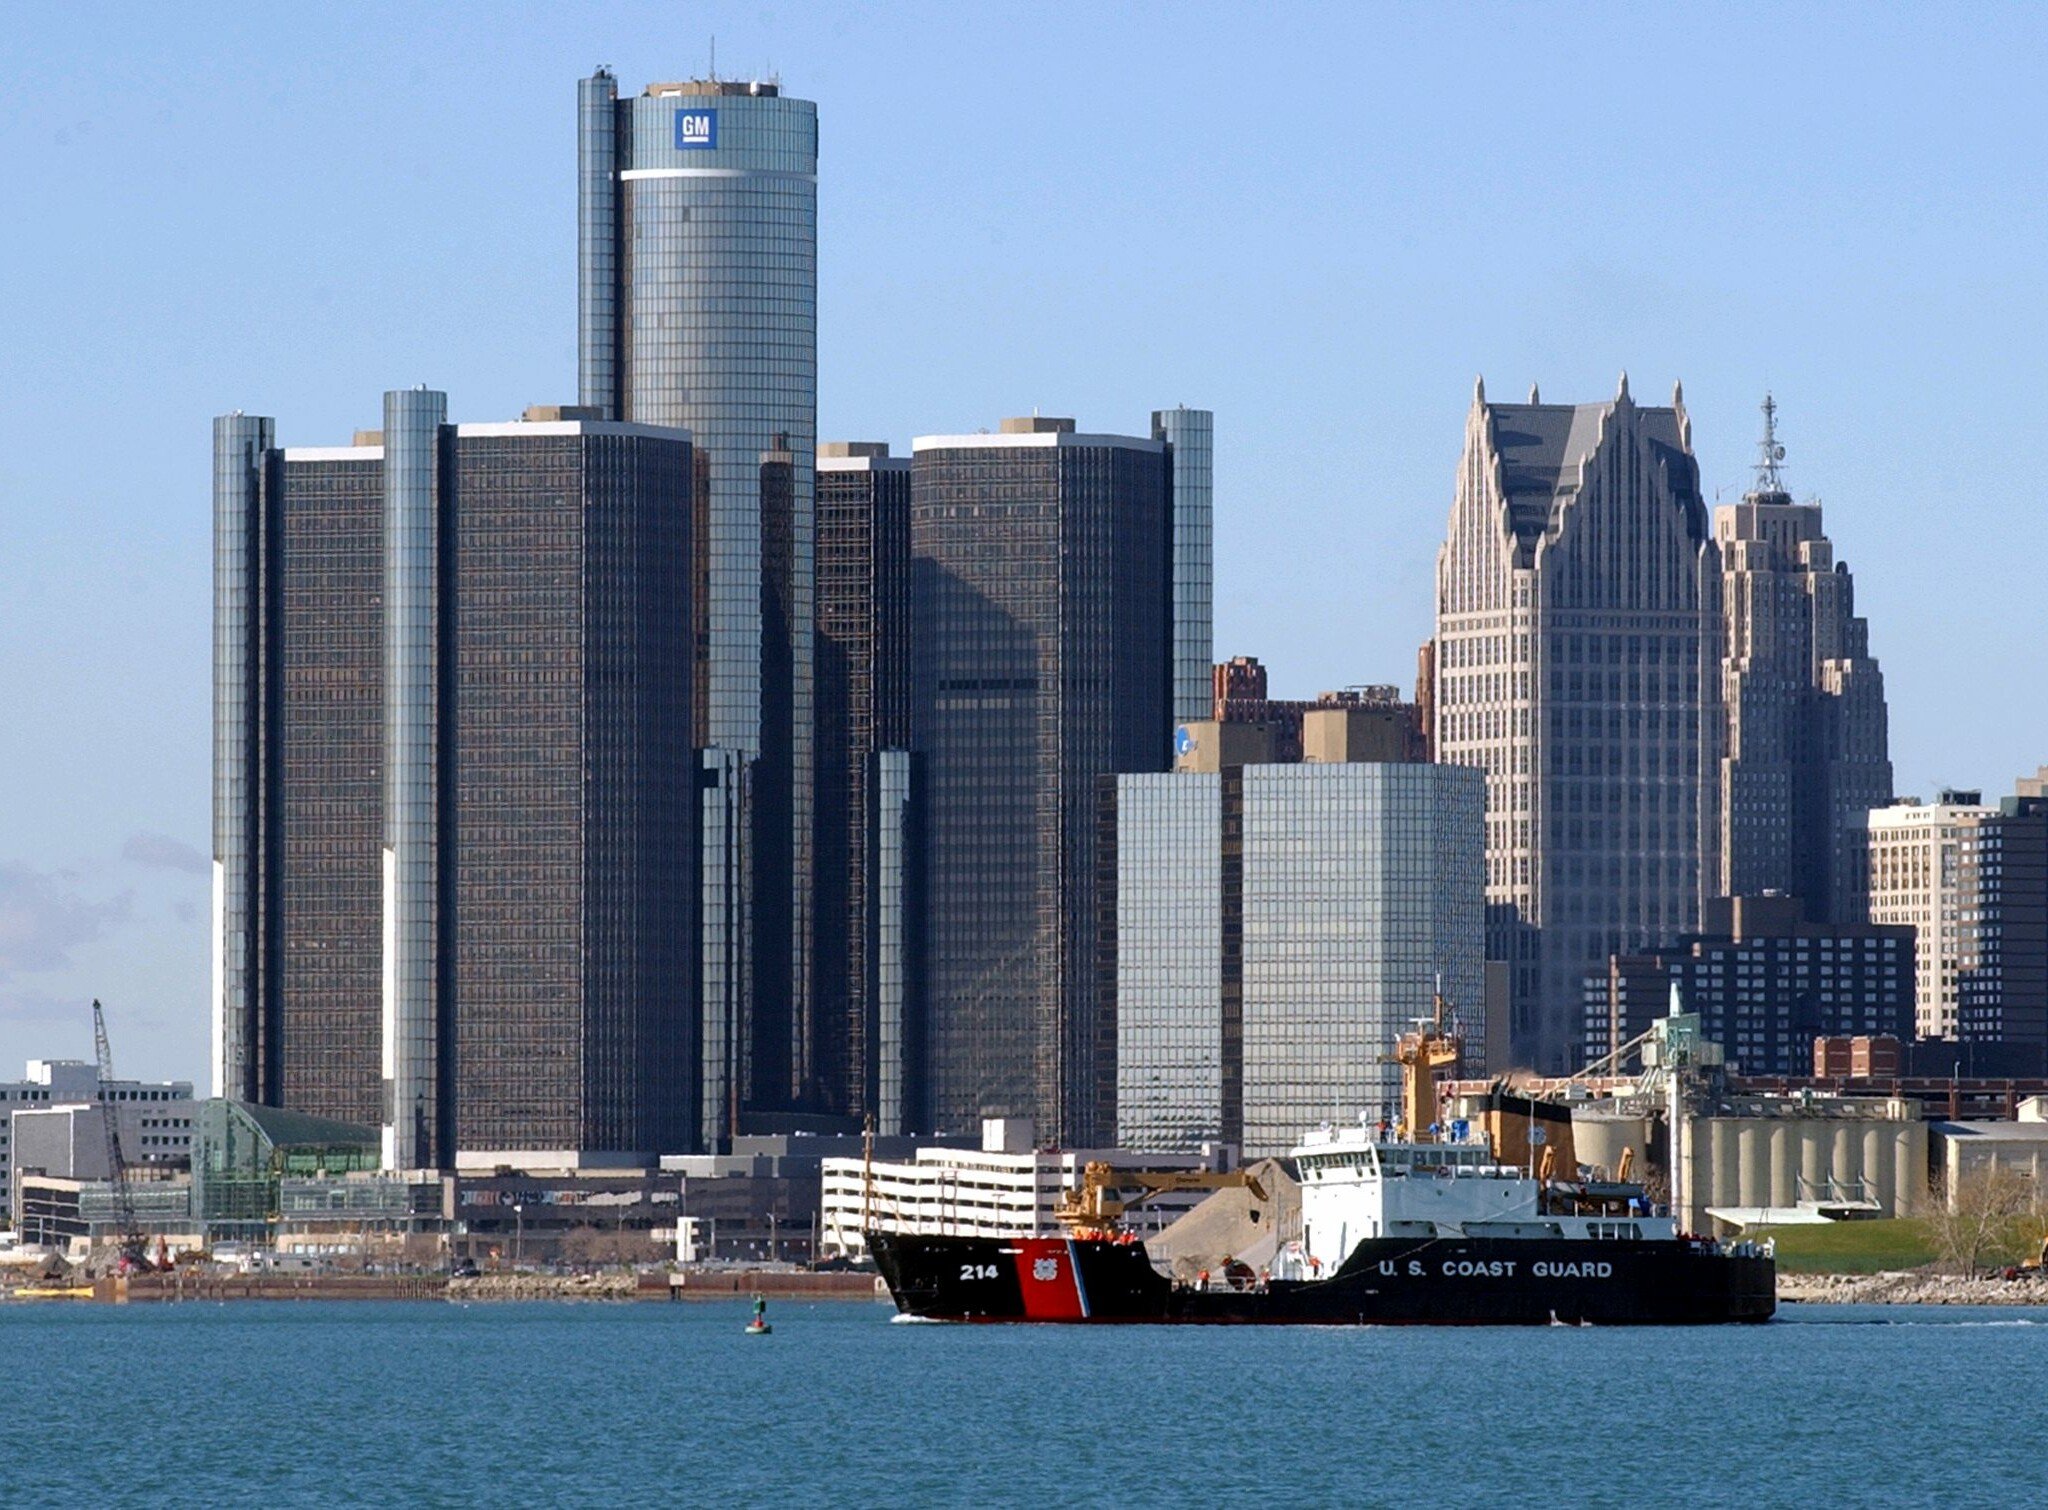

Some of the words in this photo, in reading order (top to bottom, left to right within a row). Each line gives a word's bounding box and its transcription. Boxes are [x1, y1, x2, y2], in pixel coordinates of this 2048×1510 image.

[682, 115, 710, 136] GM
[960, 1264, 999, 1280] 214
[1379, 1260, 1398, 1276] U.
[1408, 1260, 1427, 1276] S.
[1442, 1261, 1517, 1277] COAST
[1532, 1261, 1612, 1278] GUARD
